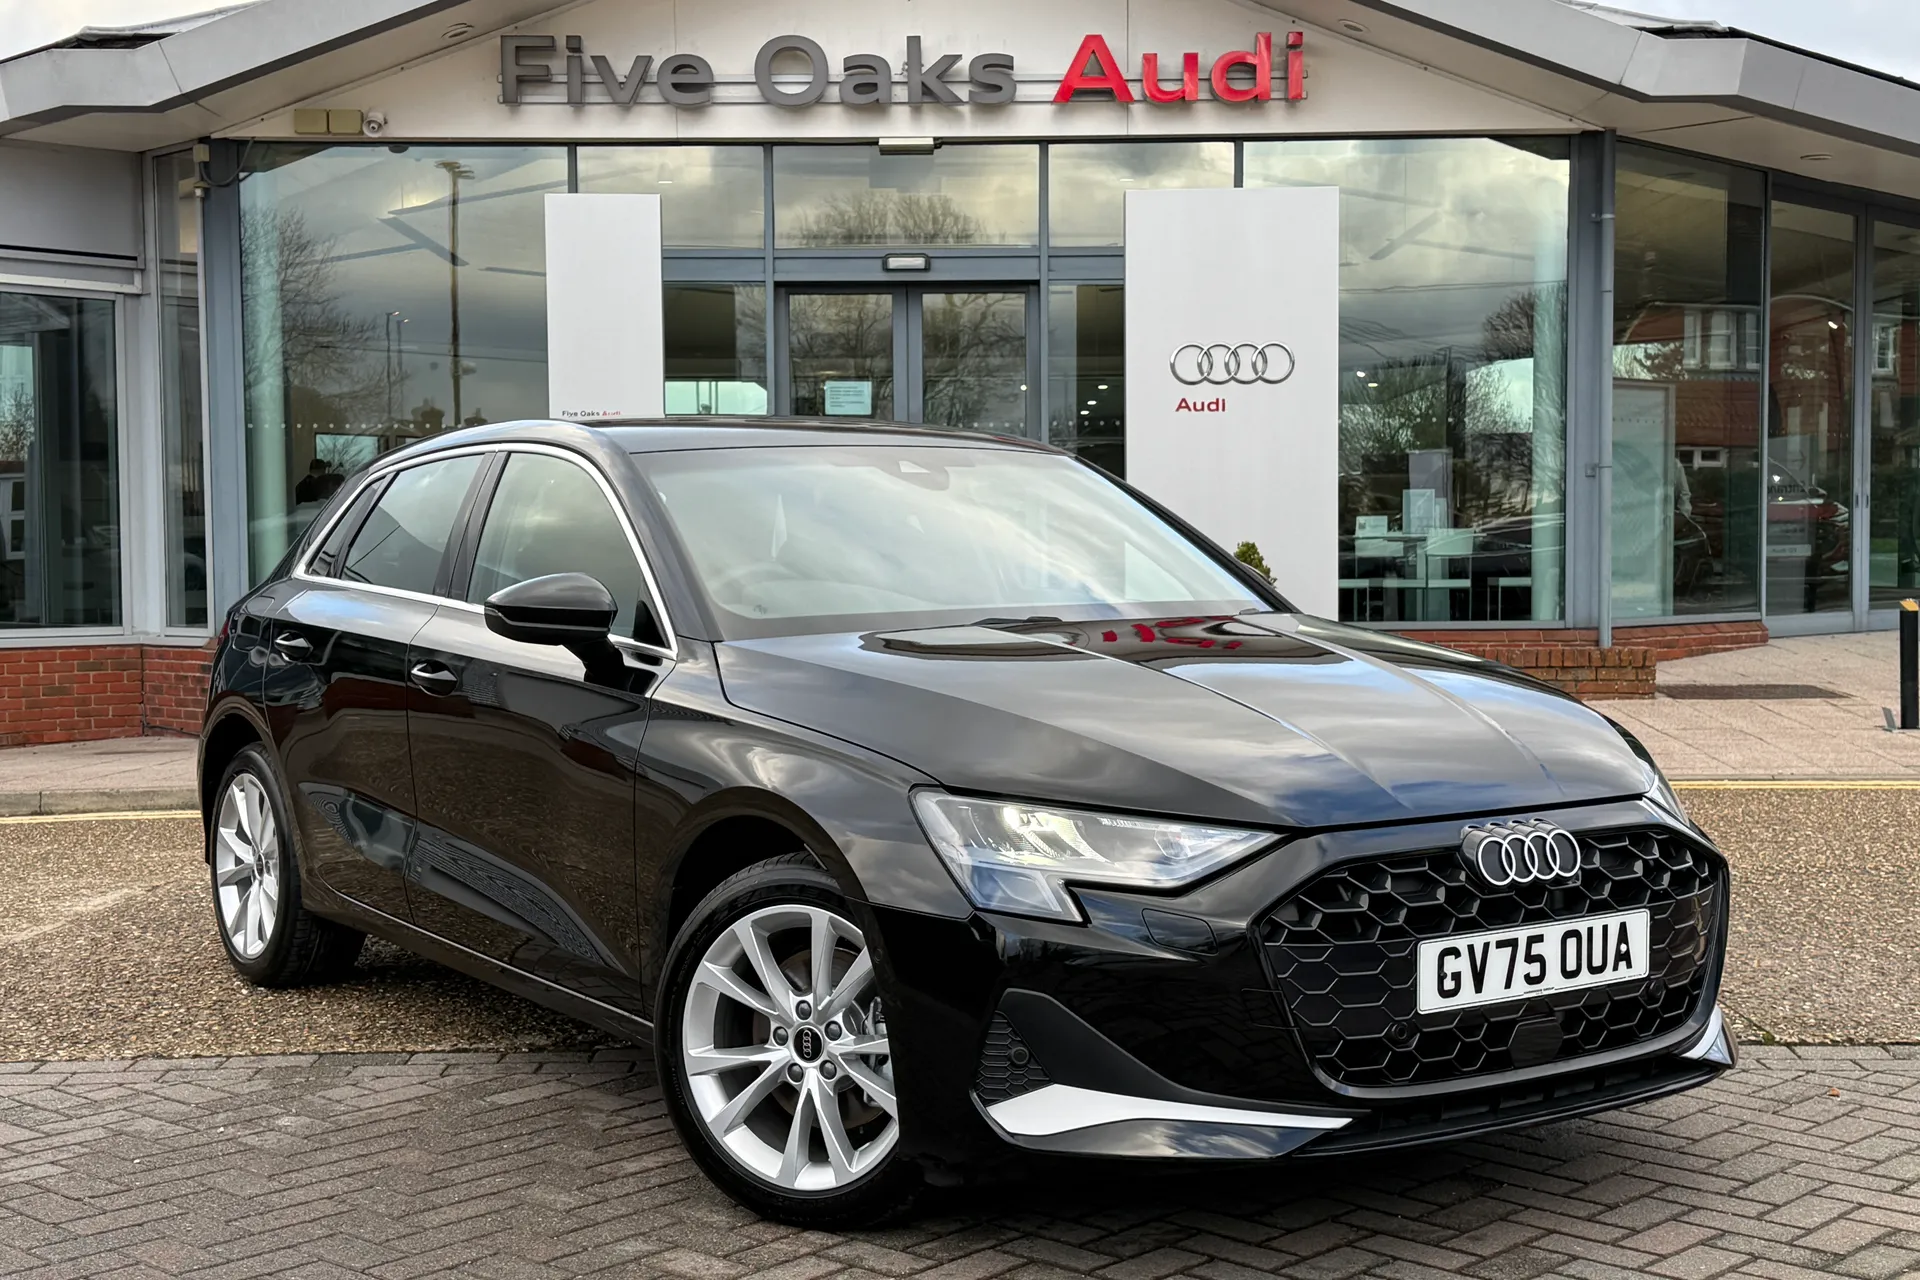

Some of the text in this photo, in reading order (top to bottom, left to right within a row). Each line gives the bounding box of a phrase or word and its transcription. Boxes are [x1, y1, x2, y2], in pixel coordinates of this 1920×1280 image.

[499, 31, 1304, 107] Five Oaks Audi
[1175, 397, 1226, 413] Audi
[1436, 921, 1633, 999] GV75 OUA
